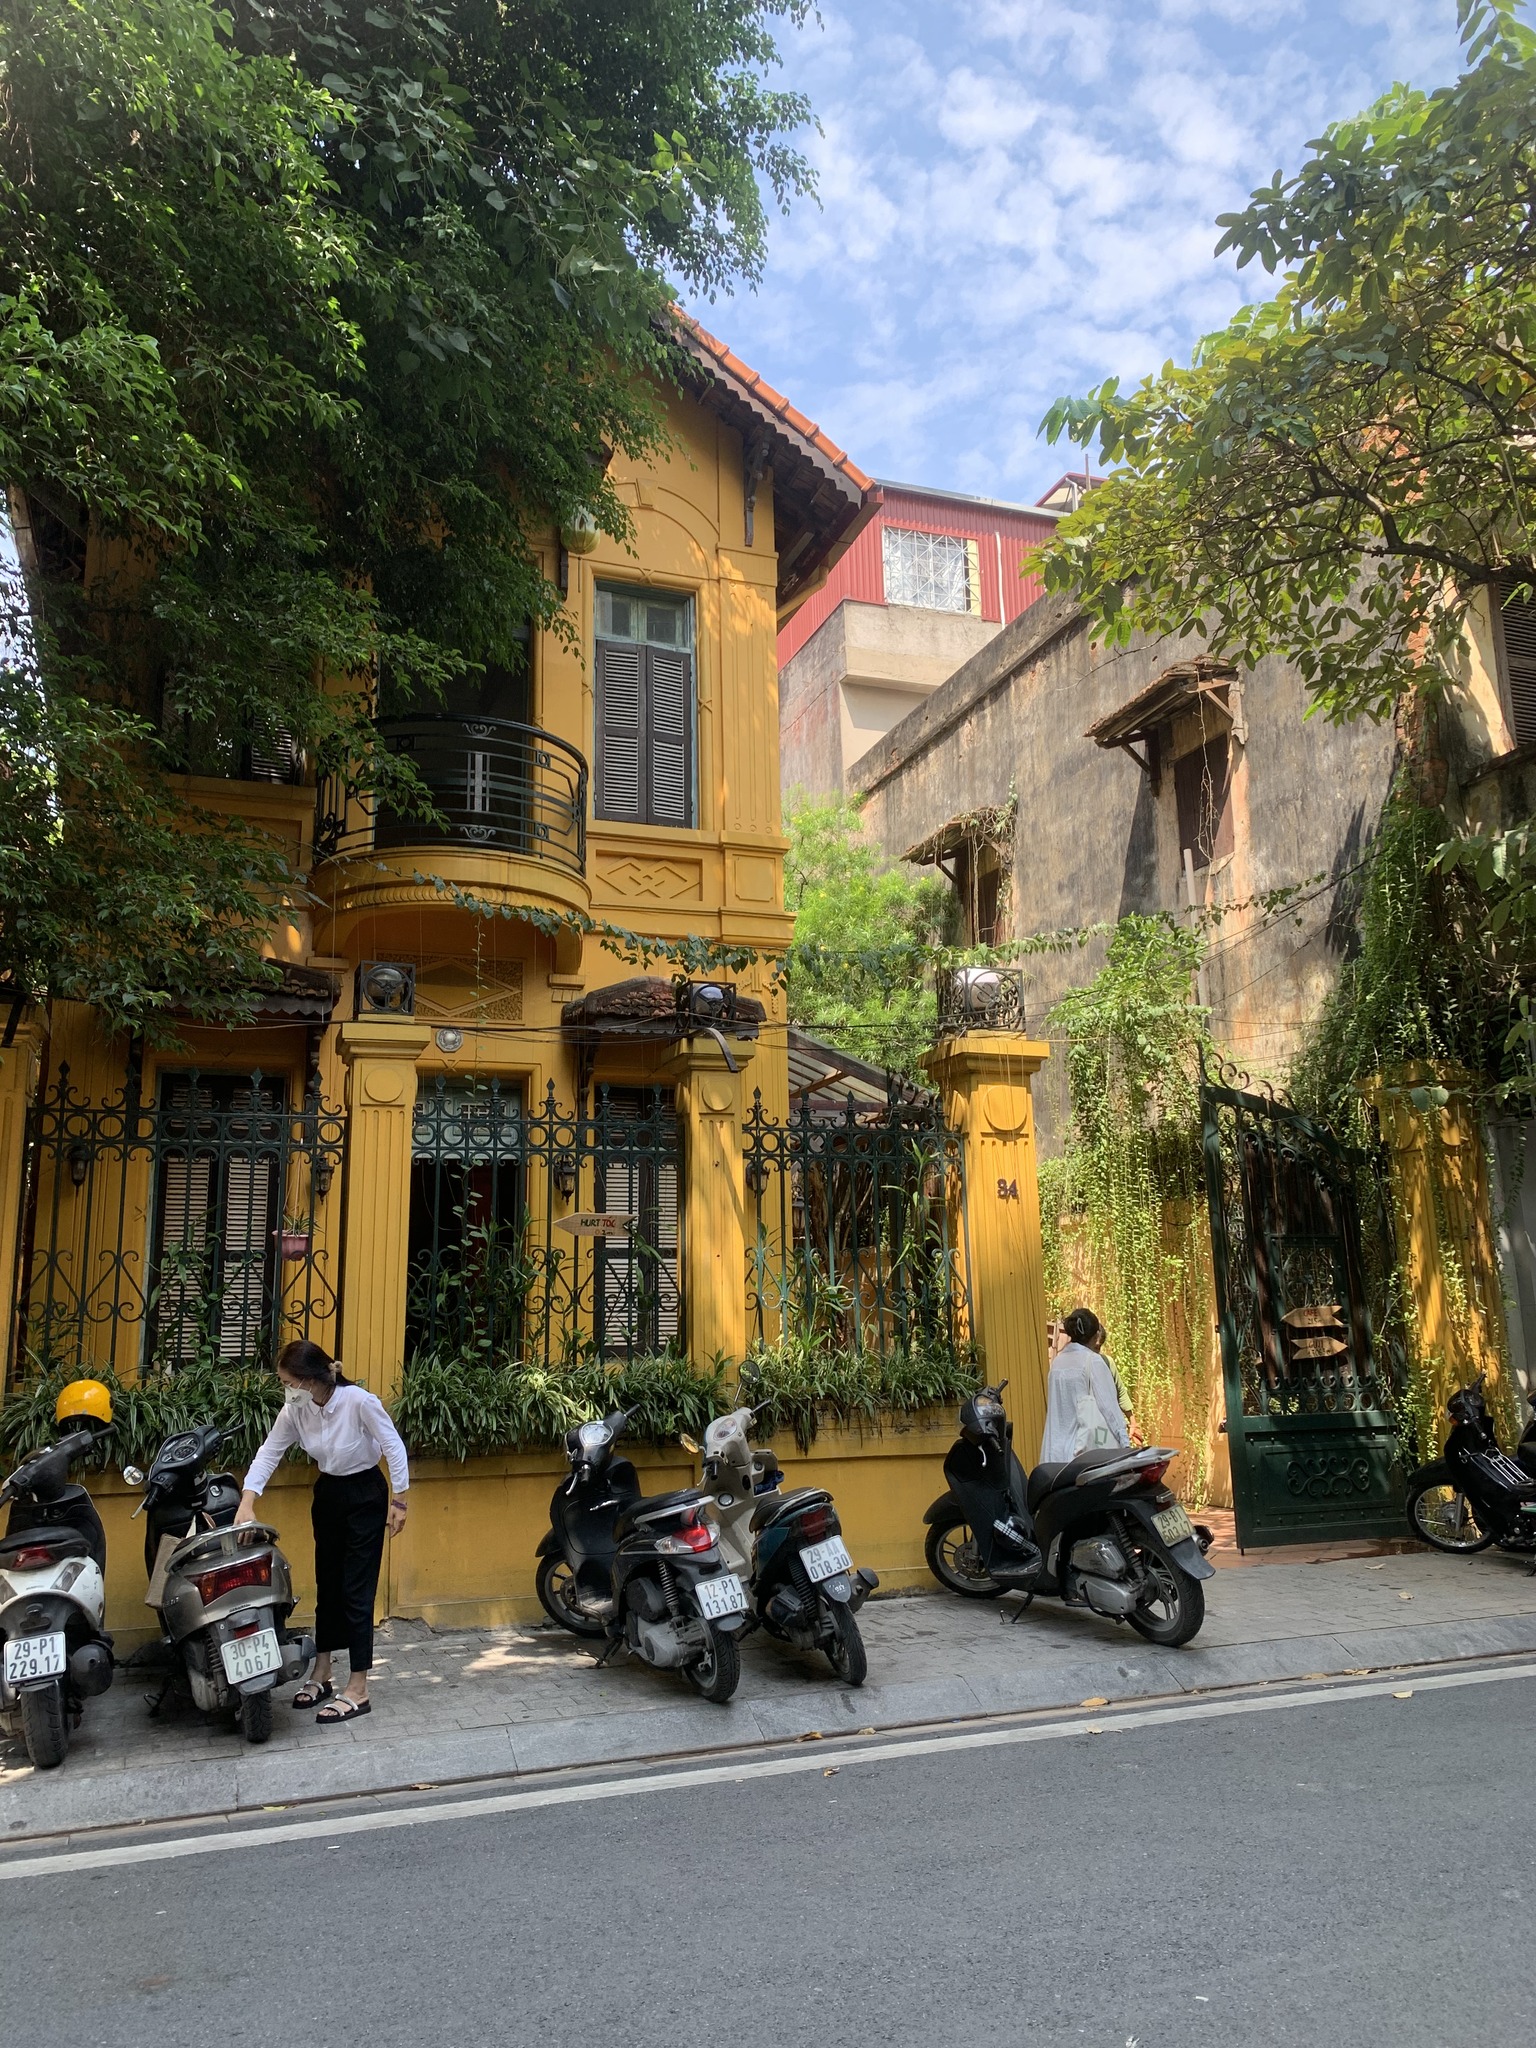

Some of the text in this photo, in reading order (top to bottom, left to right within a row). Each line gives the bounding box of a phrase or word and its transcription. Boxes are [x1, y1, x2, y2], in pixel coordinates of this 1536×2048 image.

[1157, 1508, 1183, 1529] 29-B1
[806, 1541, 841, 1564] 29-AA
[810, 1554, 850, 1580] 018.30
[704, 1578, 736, 1599] 12-P1
[705, 1593, 744, 1617] 131.87
[14, 1636, 56, 1660] 29-P1
[229, 1636, 269, 1661] 30-P4
[9, 1654, 61, 1680] 229.17
[235, 1651, 273, 1677] 4067
